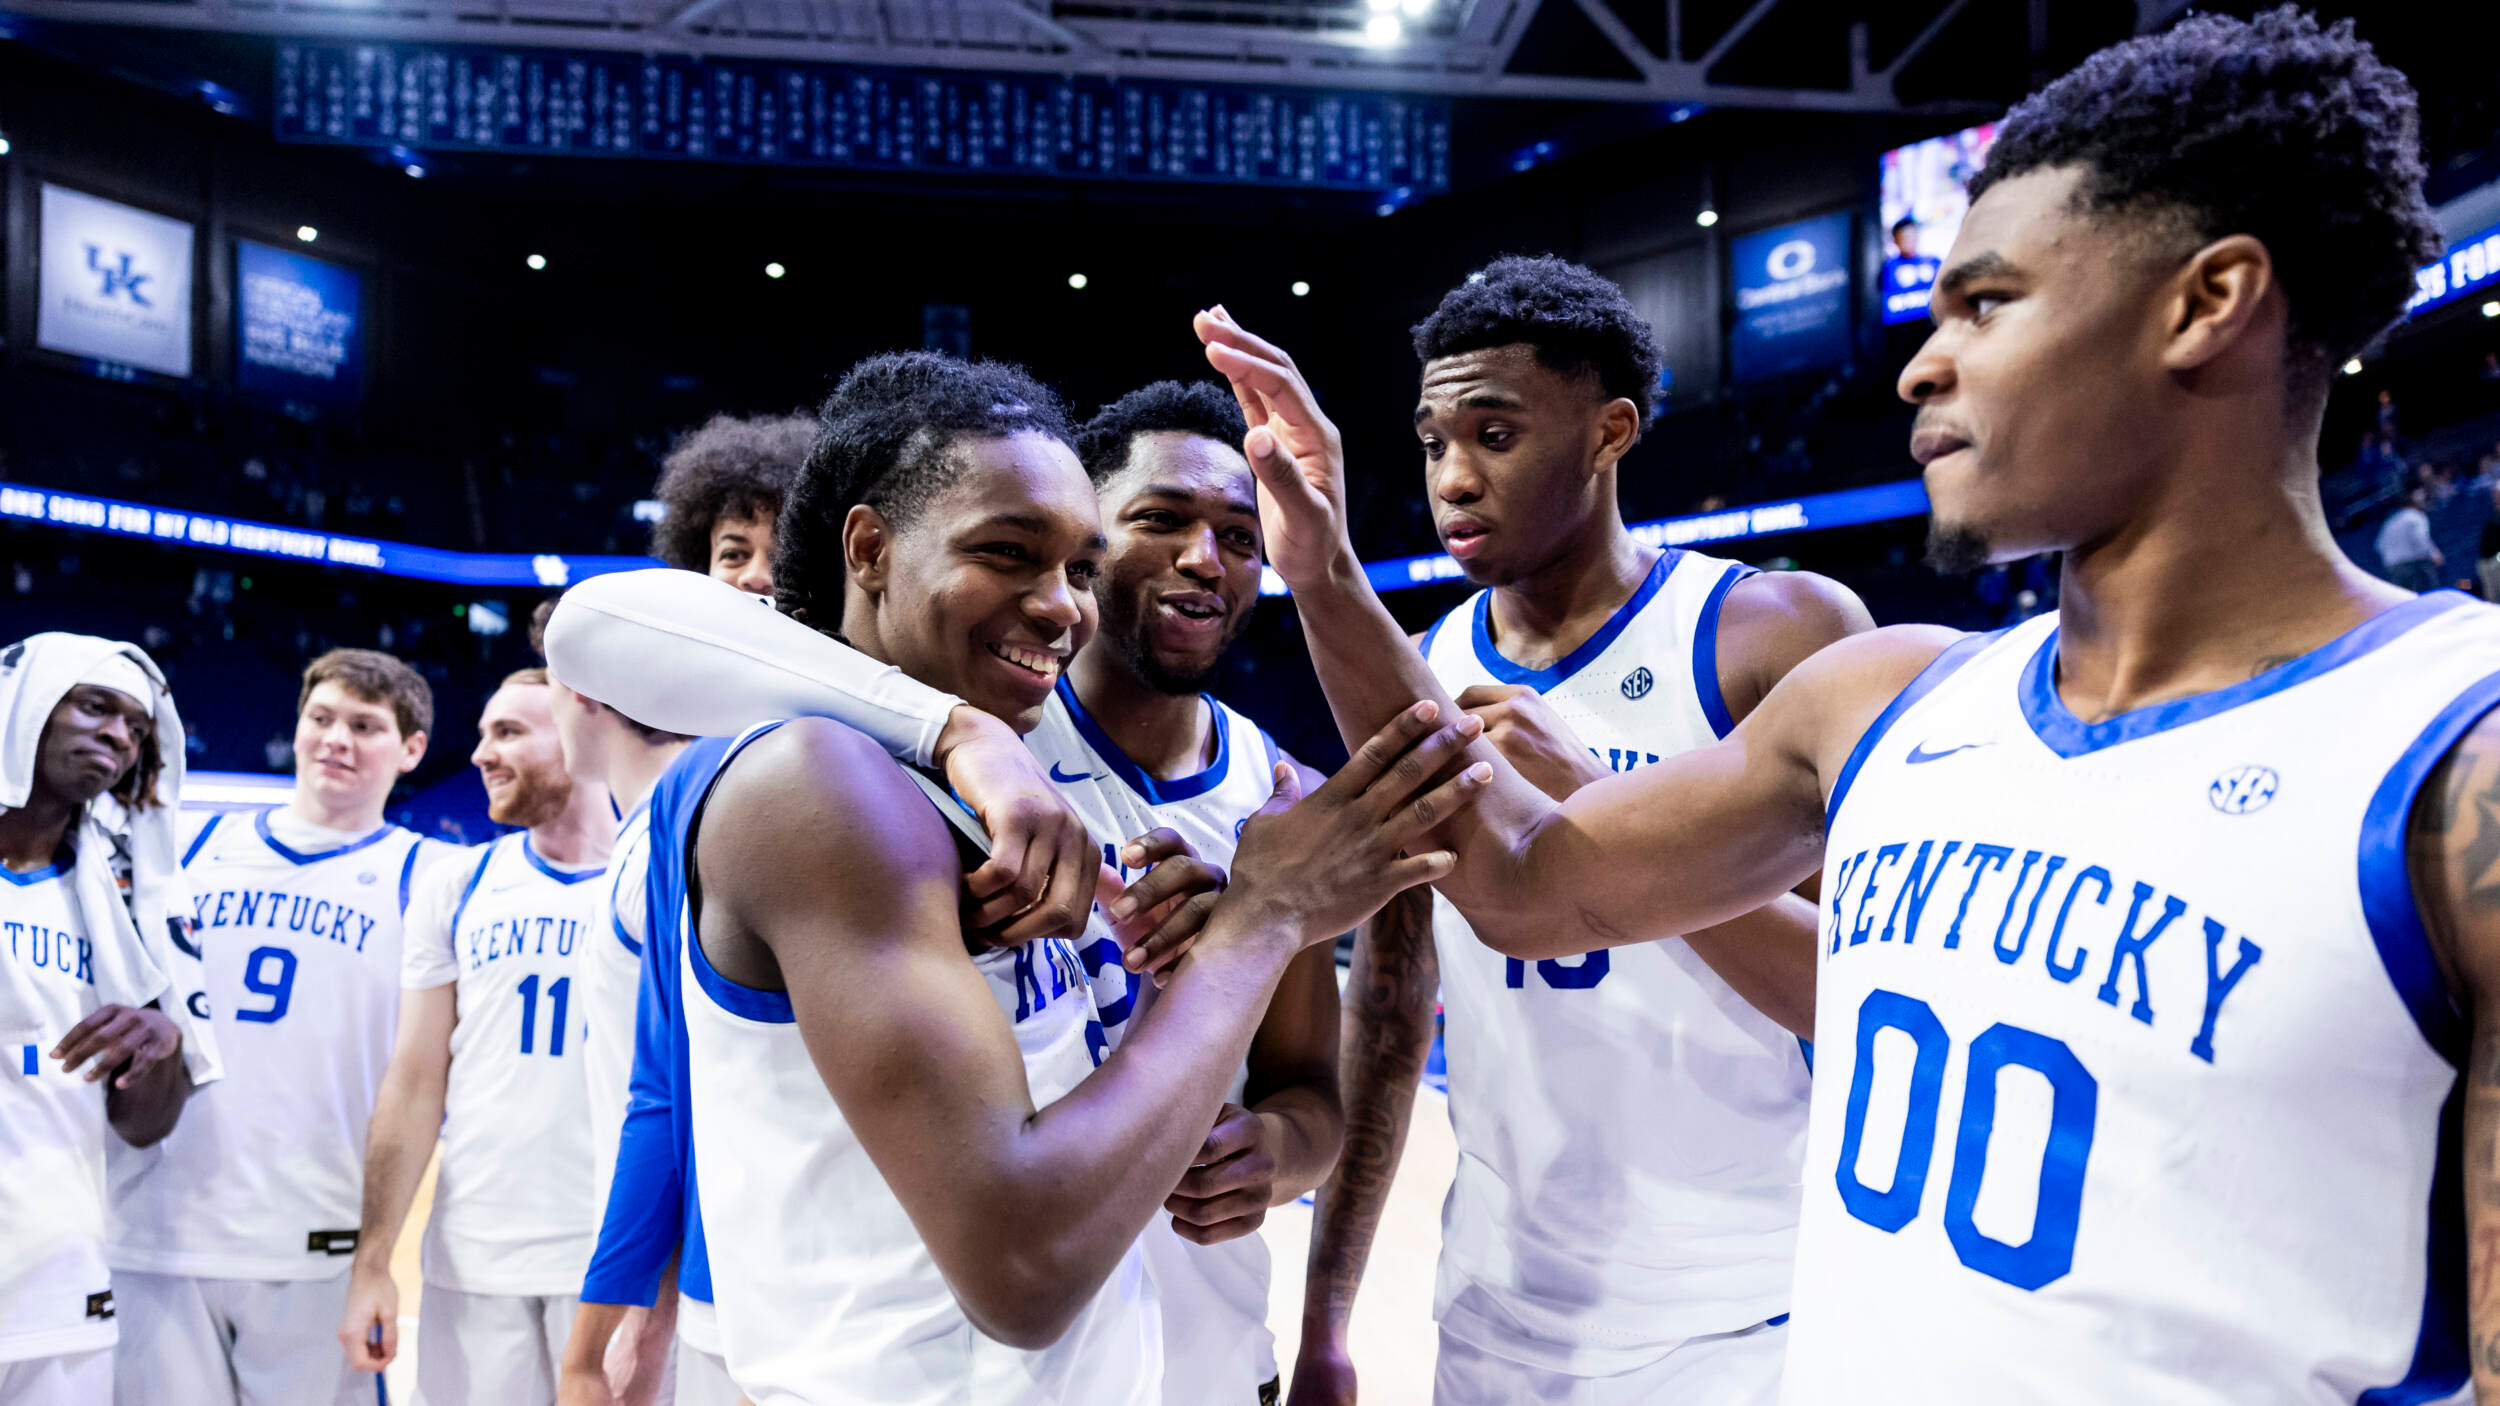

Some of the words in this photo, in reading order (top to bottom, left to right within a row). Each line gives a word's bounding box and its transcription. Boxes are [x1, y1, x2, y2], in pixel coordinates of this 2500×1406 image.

[1622, 668, 1652, 699] SEC
[2209, 766, 2279, 815] SEC
[4, 921, 95, 986] TUCK
[469, 917, 587, 971] KENTU
[1827, 840, 2262, 1064] KENTUCKY
[235, 945, 298, 1024] 9
[517, 974, 570, 1057] 11
[1835, 988, 2098, 1292] 00
